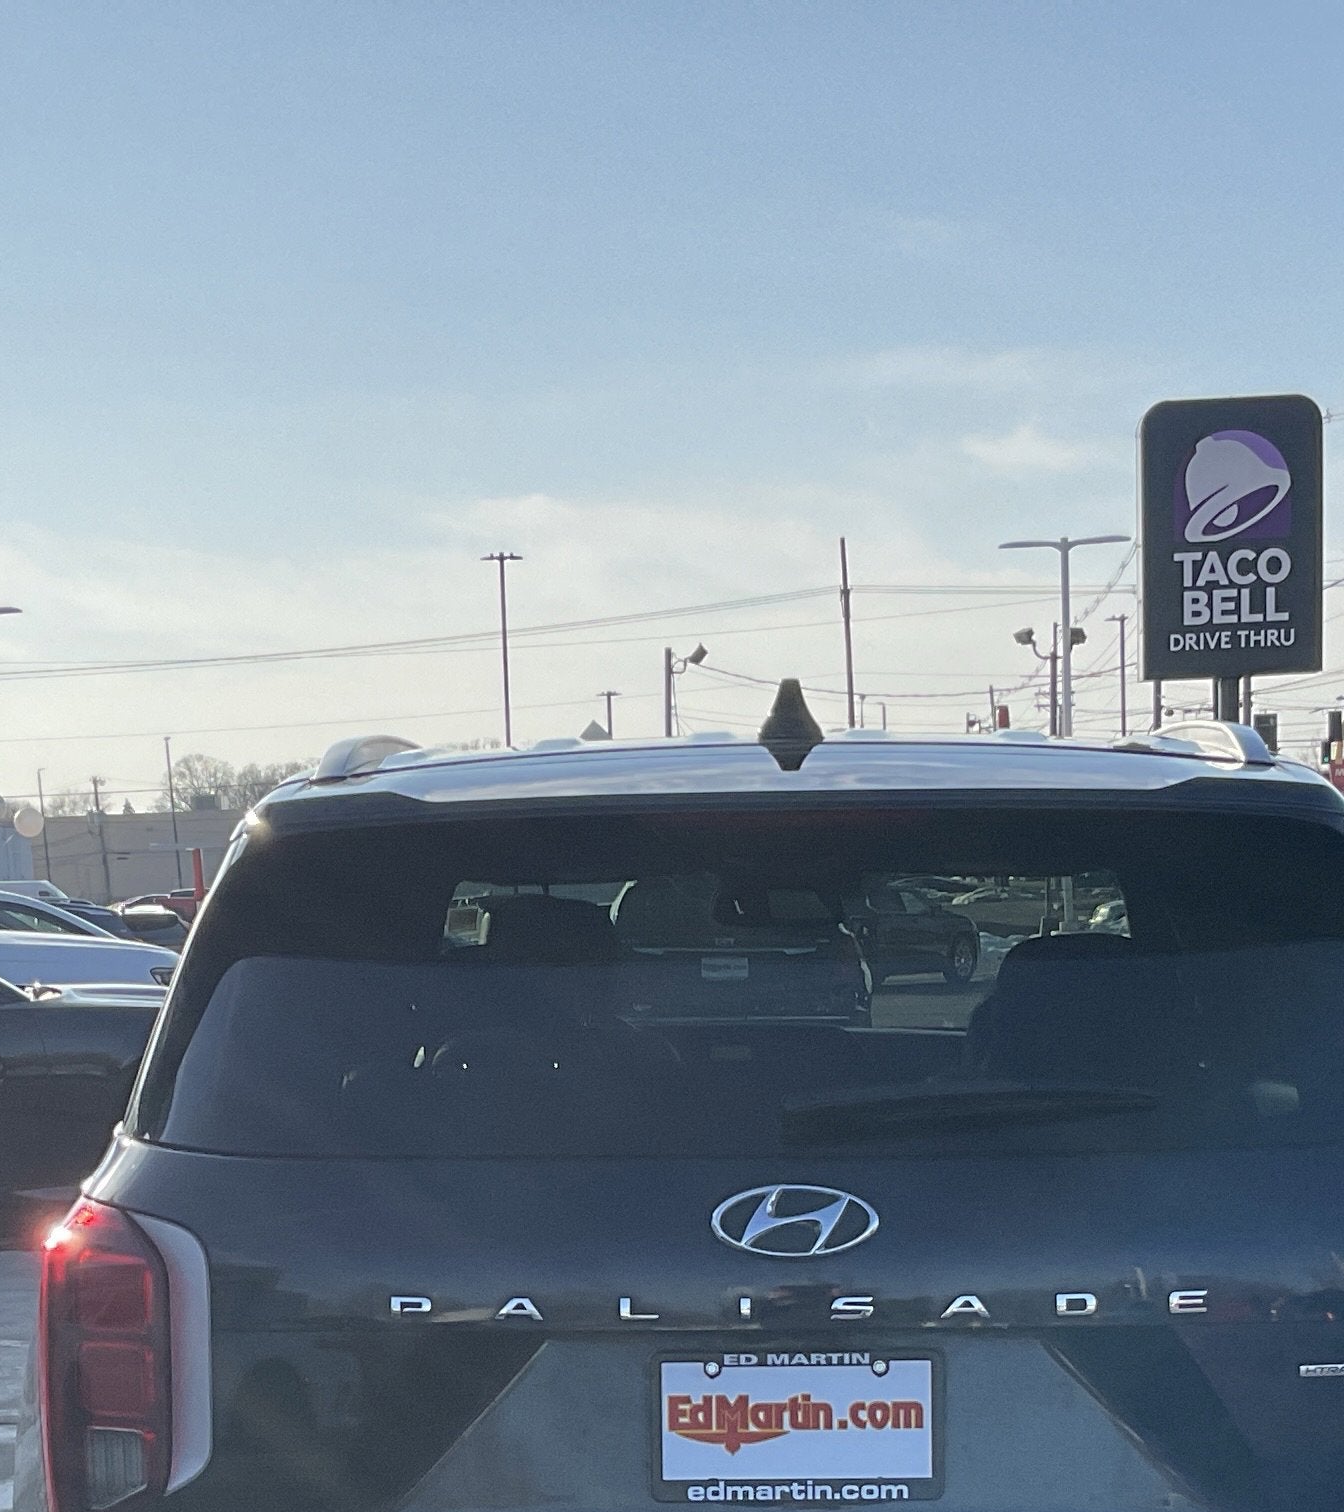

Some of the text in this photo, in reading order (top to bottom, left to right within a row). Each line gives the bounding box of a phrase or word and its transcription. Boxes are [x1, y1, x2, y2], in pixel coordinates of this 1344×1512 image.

[1173, 547, 1292, 588] TACO
[1182, 586, 1290, 626] BELL
[1169, 628, 1296, 652] DRIVE THRU
[389, 1289, 1209, 1322] PALISADE
[723, 1352, 870, 1366] ED MARTIN
[687, 1481, 909, 1501] edmartin.com
